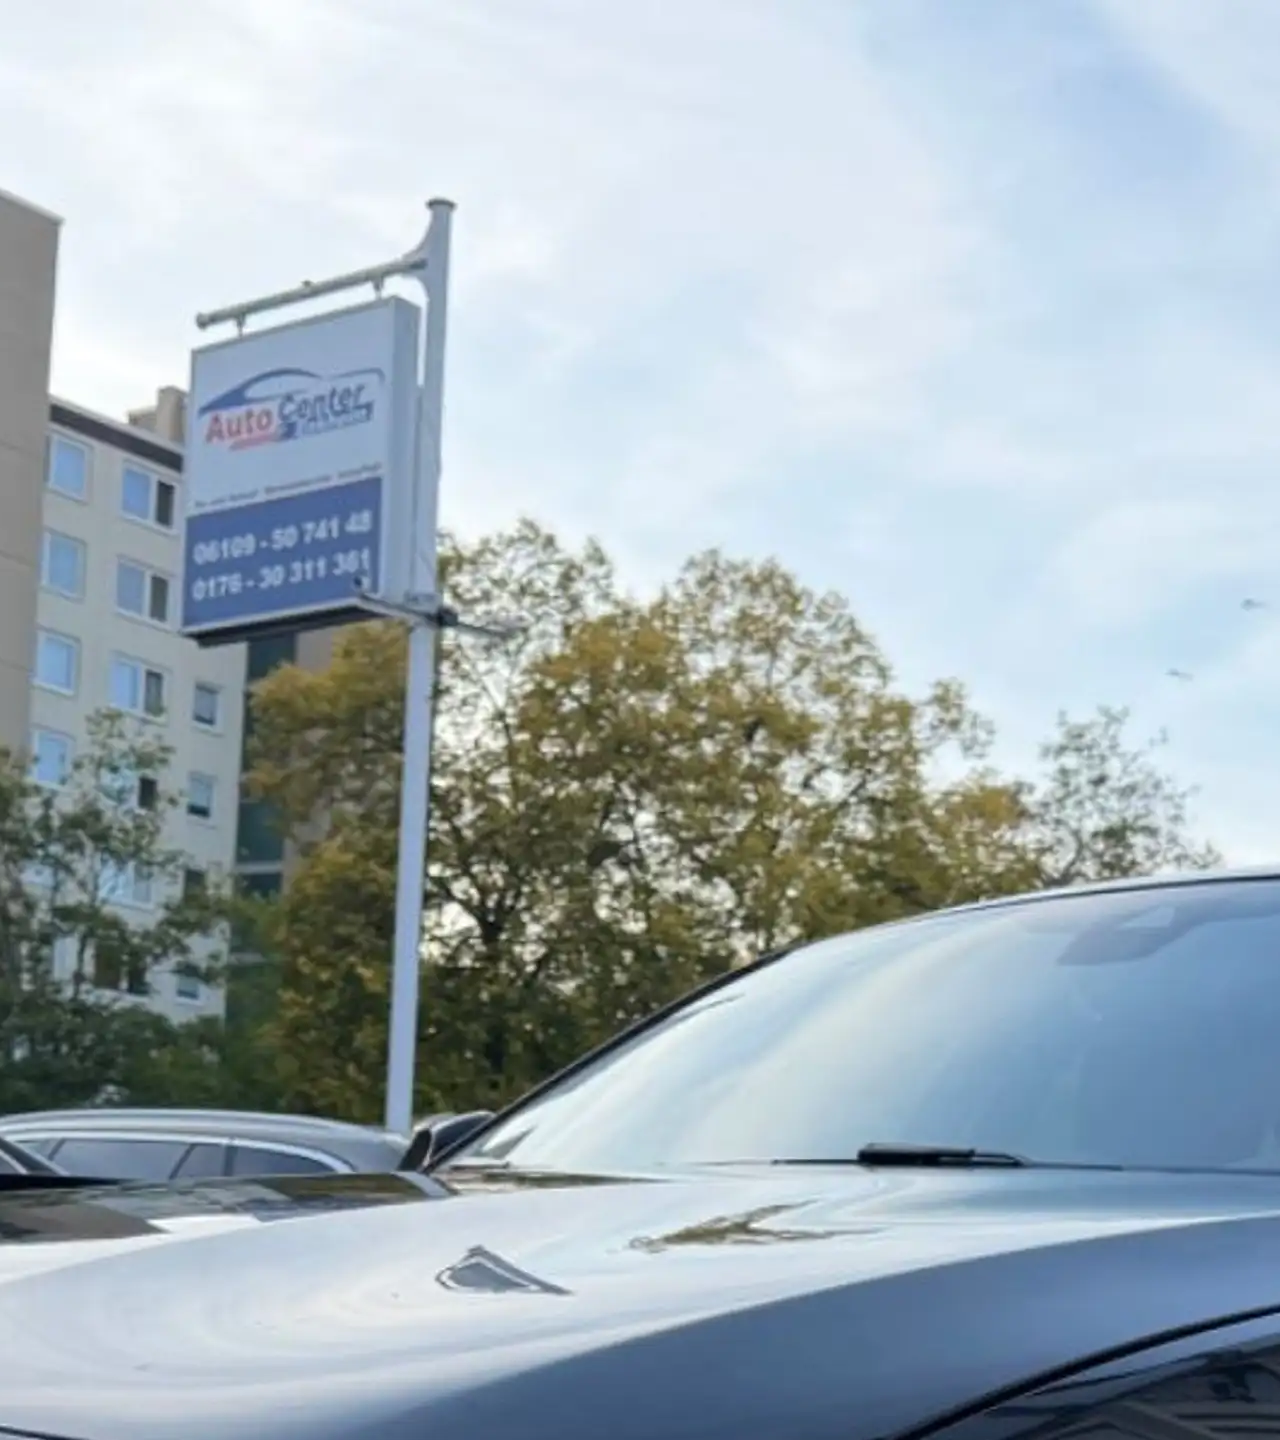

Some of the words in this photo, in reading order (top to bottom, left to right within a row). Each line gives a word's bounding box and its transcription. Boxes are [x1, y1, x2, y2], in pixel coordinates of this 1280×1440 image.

[205, 408, 274, 444] Auto
[278, 384, 366, 422] Center
[302, 516, 340, 544] 741
